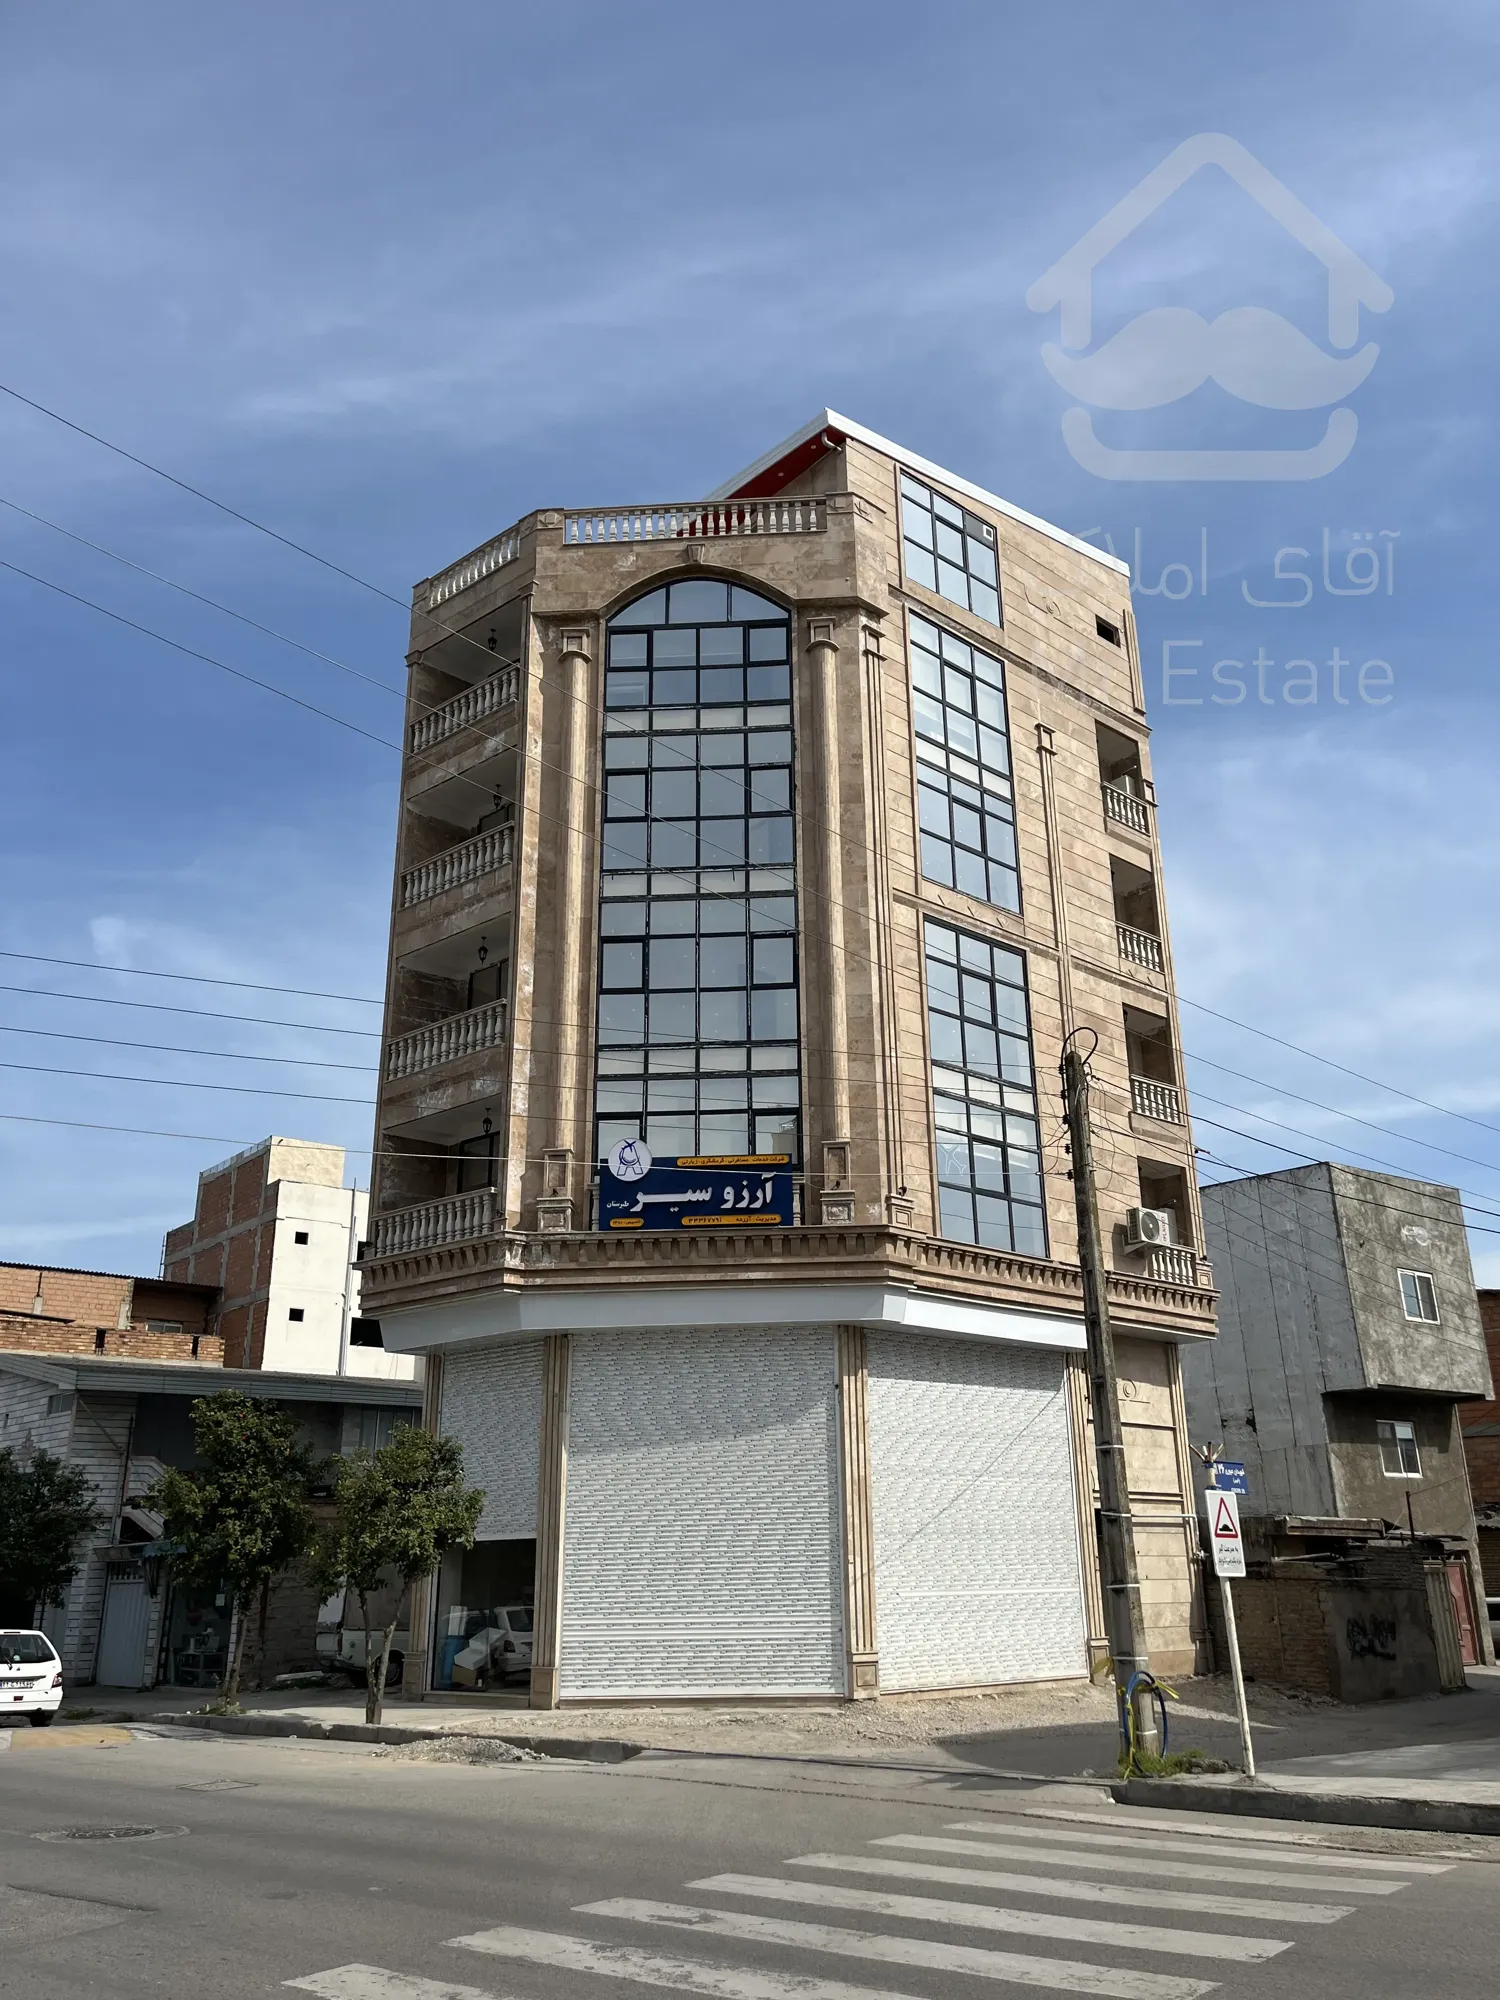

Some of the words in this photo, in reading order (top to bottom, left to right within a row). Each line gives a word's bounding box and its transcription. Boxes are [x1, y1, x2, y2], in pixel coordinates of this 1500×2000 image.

[769, 1155, 785, 1163] شرکت
[720, 1171, 777, 1209] آرزو
[606, 1200, 630, 1209] طبرستان
[629, 1186, 713, 1212] سیر
